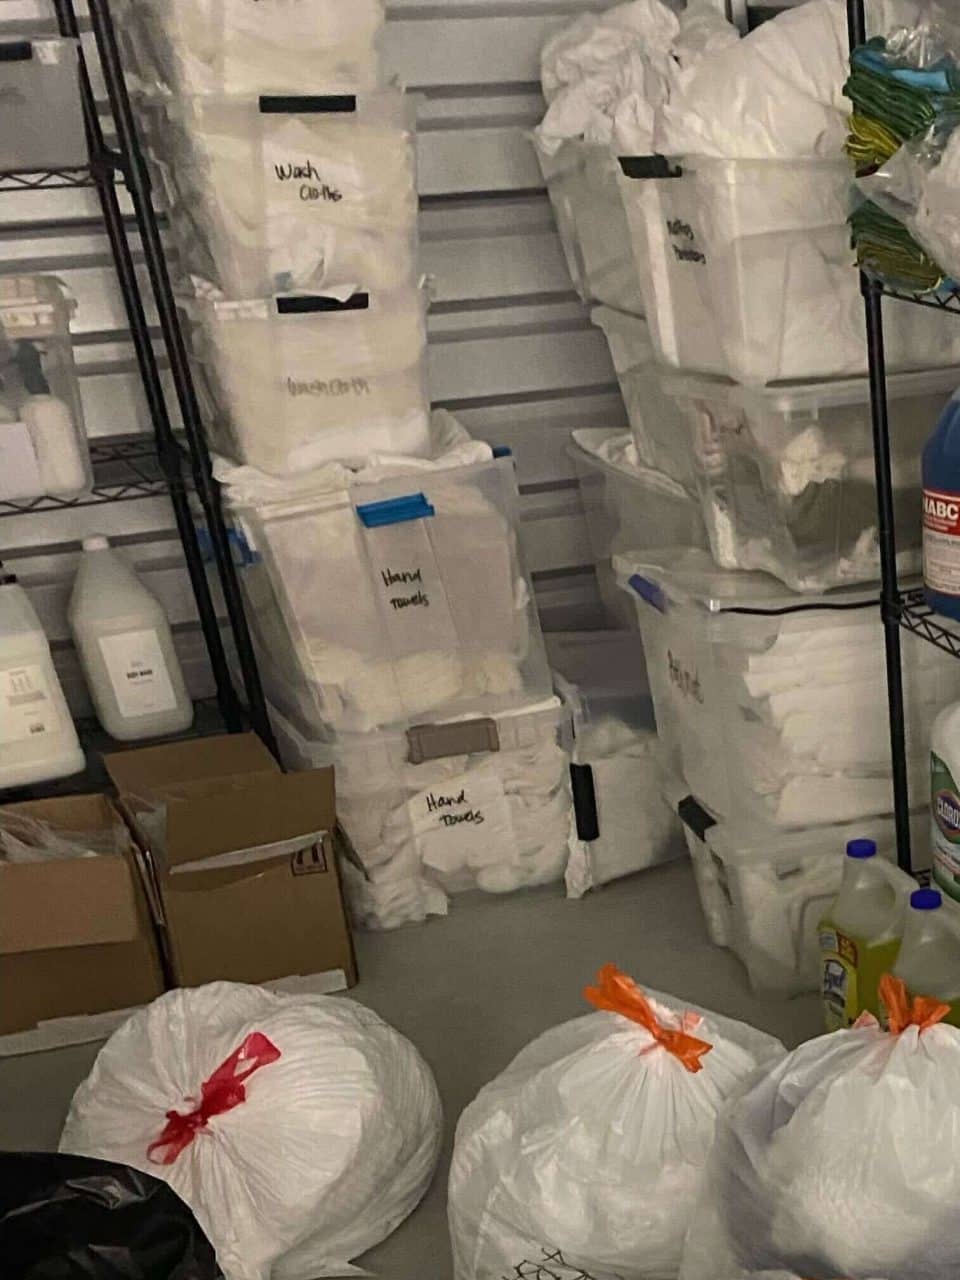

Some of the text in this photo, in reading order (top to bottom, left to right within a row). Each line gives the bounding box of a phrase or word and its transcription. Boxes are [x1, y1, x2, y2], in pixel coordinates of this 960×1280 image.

[274, 160, 321, 181] Wash
[381, 568, 423, 587] Hand
[426, 789, 468, 812] Hand
